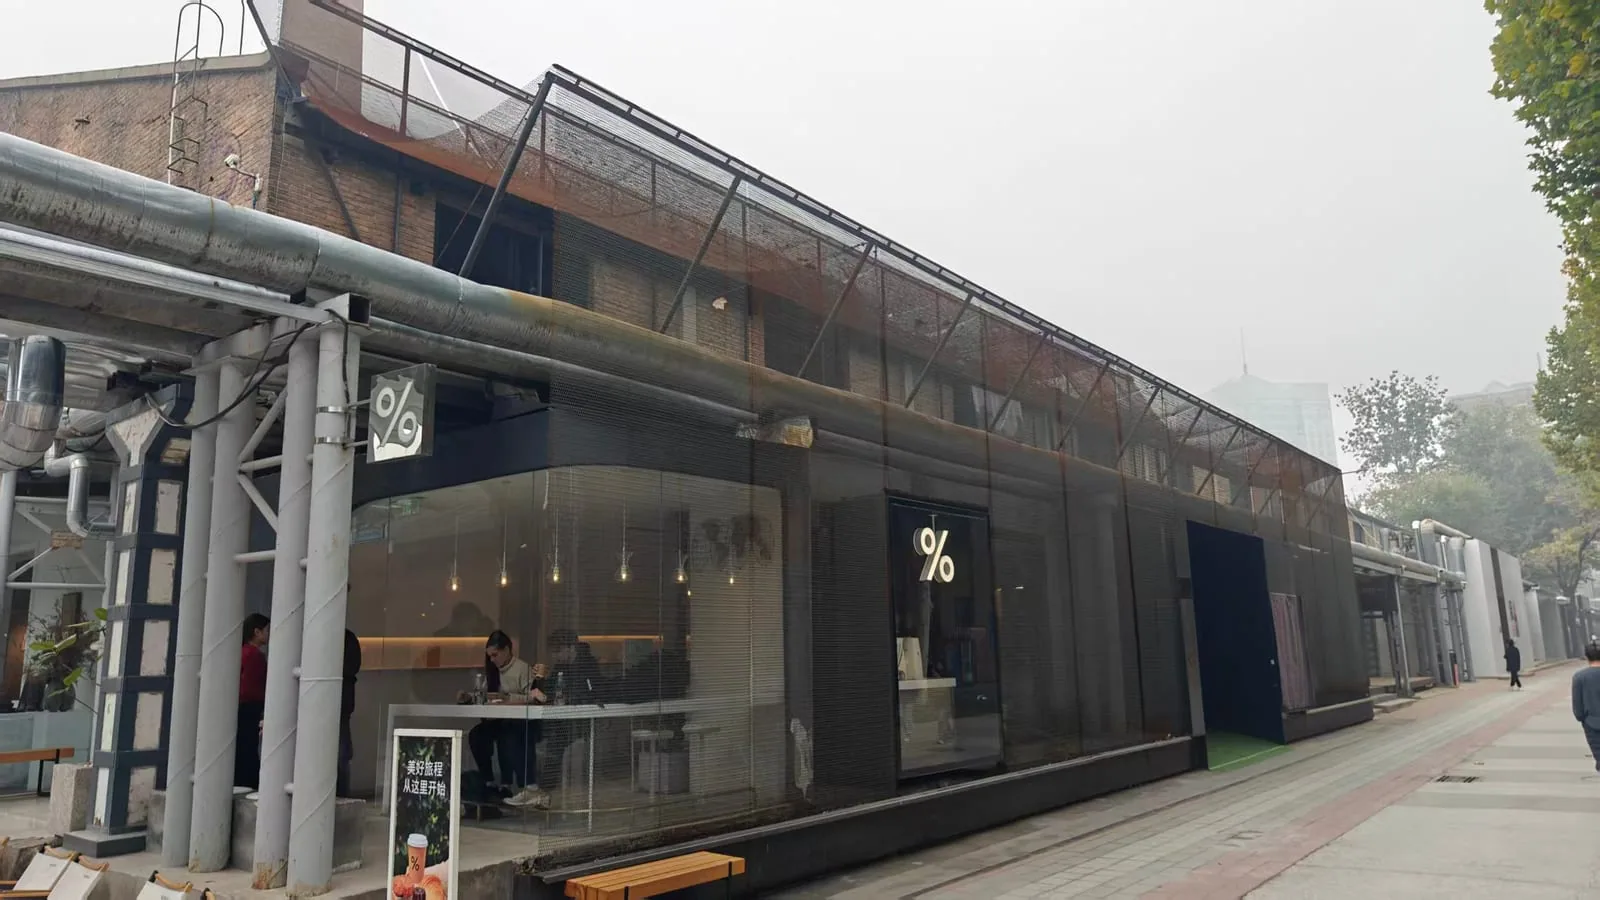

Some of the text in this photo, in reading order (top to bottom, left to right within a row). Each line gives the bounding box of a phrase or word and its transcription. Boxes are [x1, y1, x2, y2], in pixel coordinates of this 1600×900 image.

[376, 380, 417, 448] %
[914, 527, 955, 583] %
[407, 760, 443, 777] 美好旅程
[403, 778, 446, 799] 从这里开始
[410, 855, 420, 872] %
